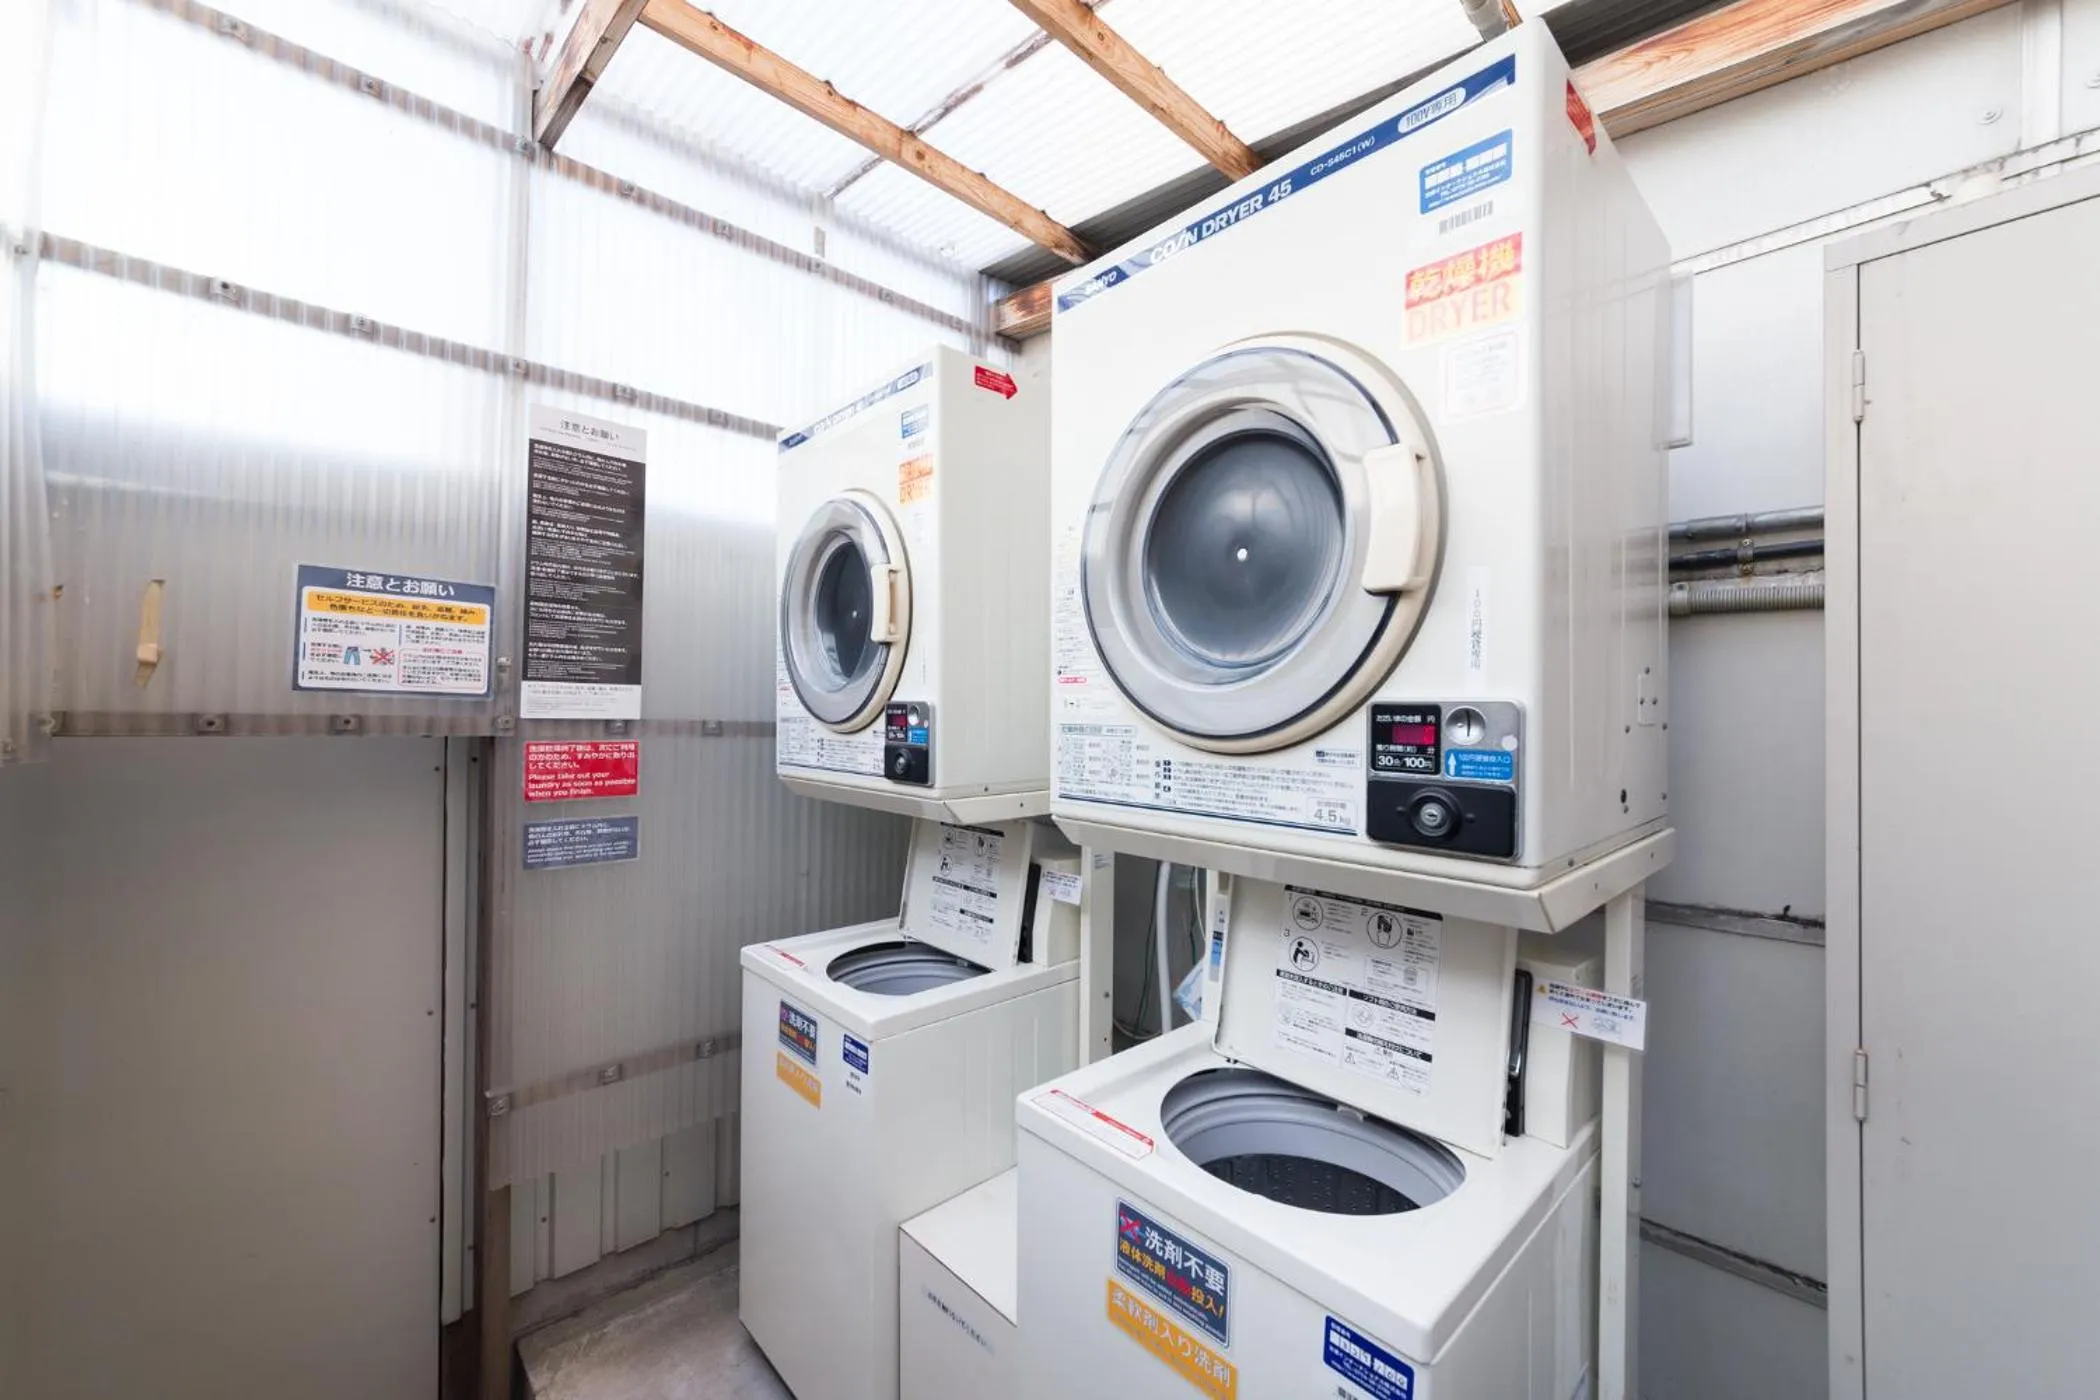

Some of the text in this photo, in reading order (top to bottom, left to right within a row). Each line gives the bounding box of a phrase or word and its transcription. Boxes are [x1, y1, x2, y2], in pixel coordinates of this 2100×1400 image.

[1149, 180, 1292, 265] COIN DRYER 45
[1408, 281, 1511, 343] DRYER
[560, 420, 620, 441] 注意とお願い
[346, 573, 455, 596] 注意とお願い
[528, 781, 560, 790] laundry
[592, 772, 610, 780] your
[528, 790, 551, 798] when
[553, 790, 569, 798] you
[1144, 1226, 1225, 1297] 洗剤不要
